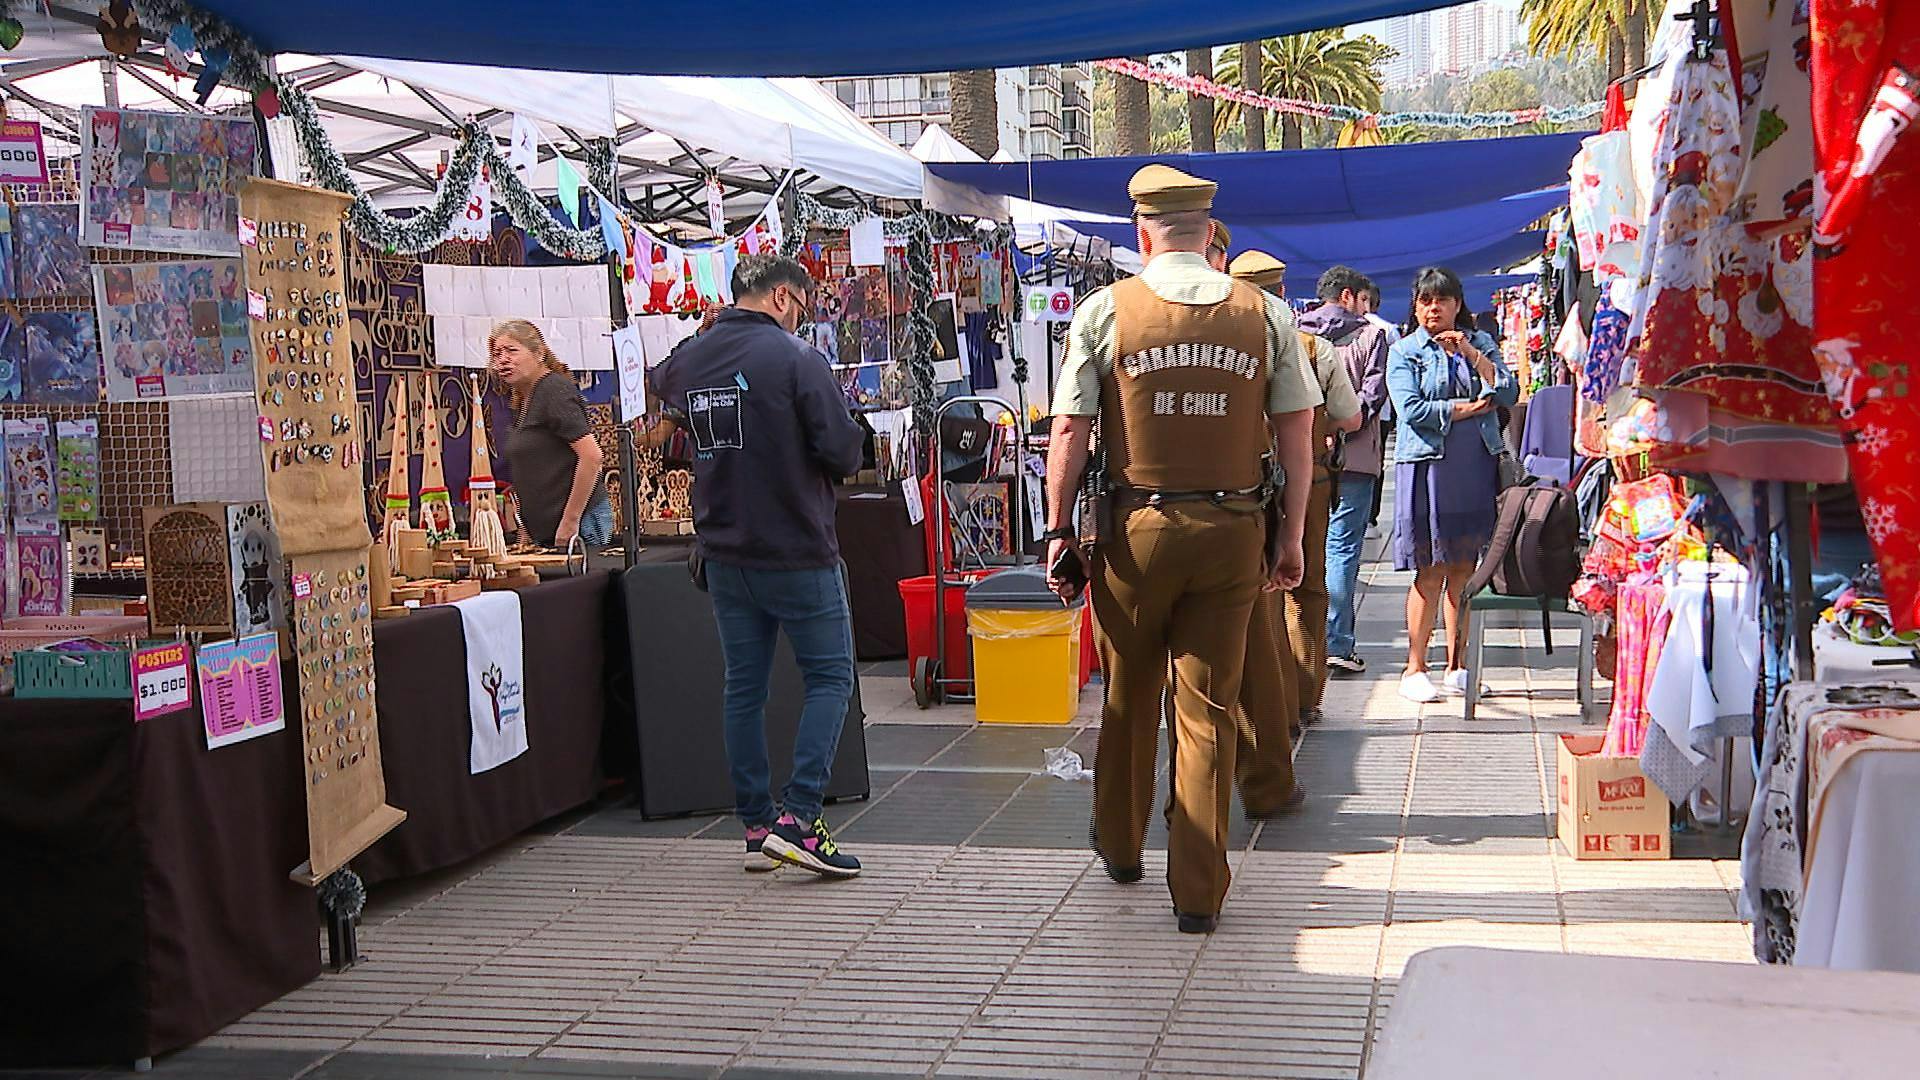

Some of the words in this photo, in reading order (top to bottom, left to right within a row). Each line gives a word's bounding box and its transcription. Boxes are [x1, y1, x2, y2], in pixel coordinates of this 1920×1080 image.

[465, 195, 483, 221] 8
[1122, 343, 1260, 381] CARABINEROS
[1153, 391, 1177, 415] DE
[1181, 391, 1229, 417] CHILE
[138, 646, 184, 669] POSTERS
[140, 677, 186, 699] $1.000
